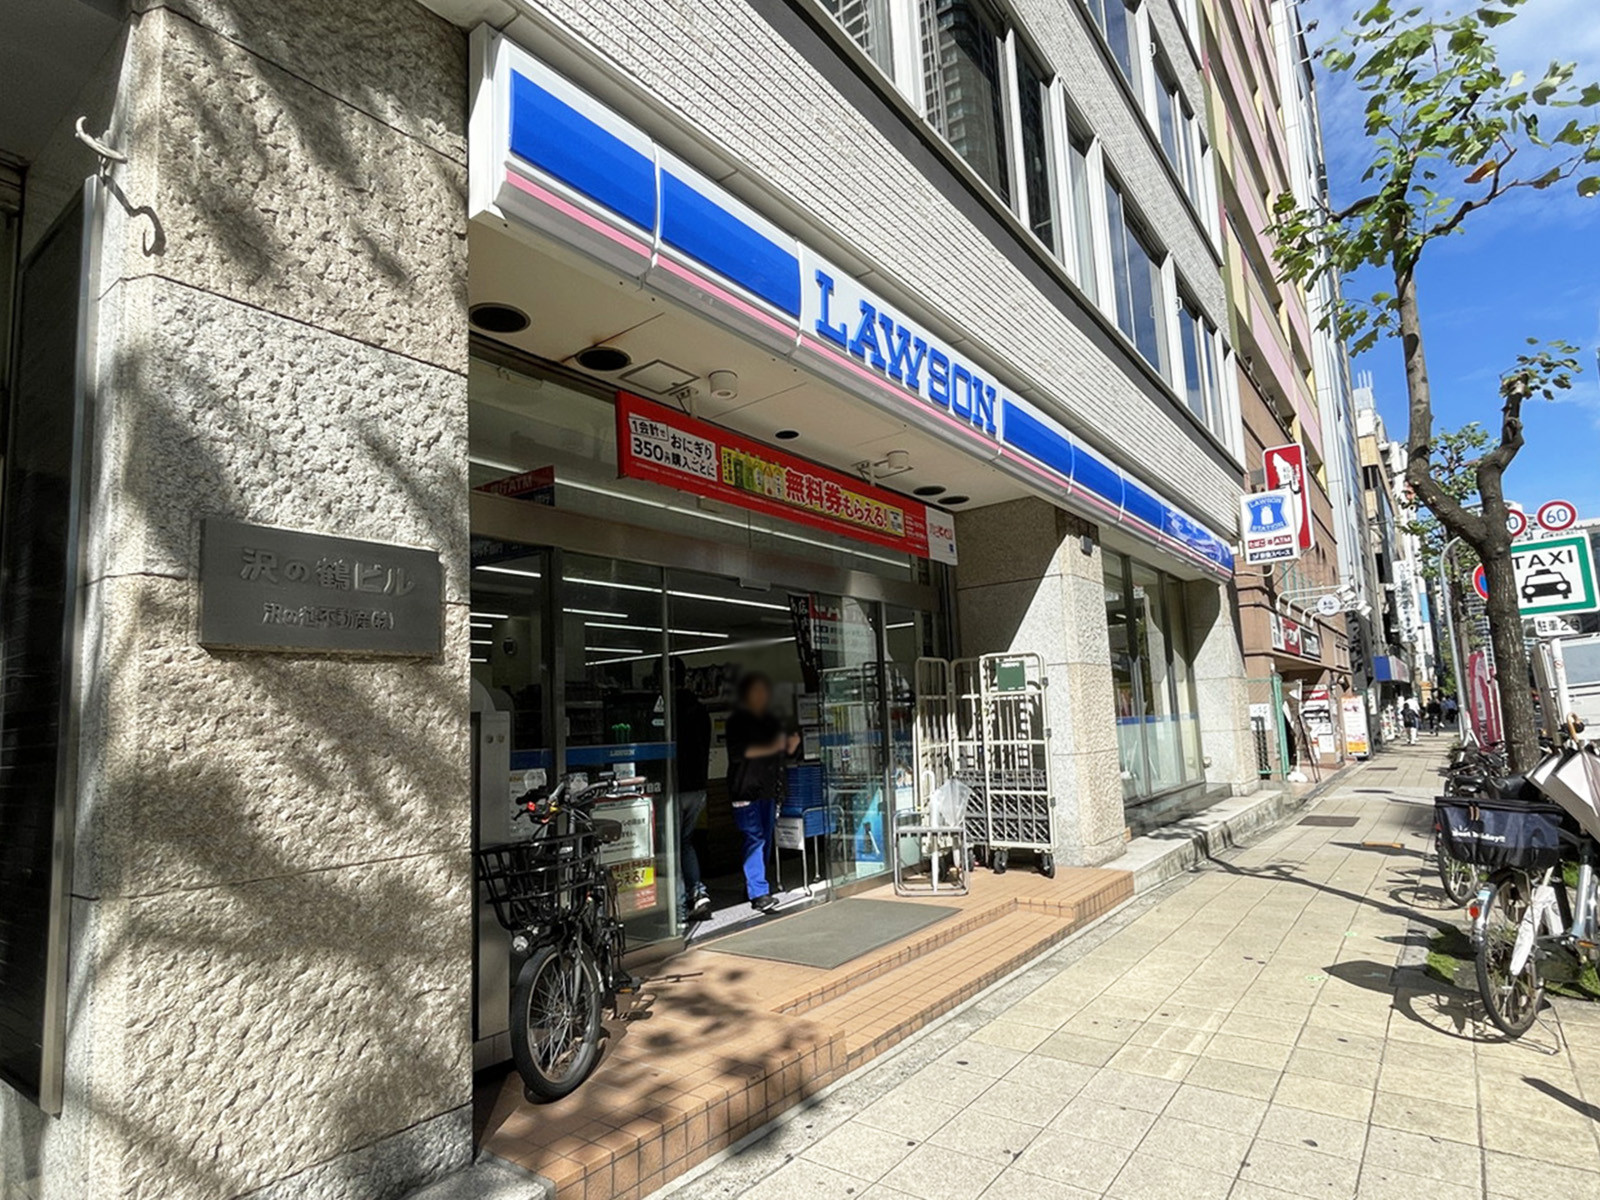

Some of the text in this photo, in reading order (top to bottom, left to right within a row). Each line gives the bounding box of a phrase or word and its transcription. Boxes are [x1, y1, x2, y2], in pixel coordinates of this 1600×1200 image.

[815, 269, 996, 436] LAWSON
[671, 433, 713, 460] おにぎり
[1546, 508, 1568, 524] 60
[240, 548, 415, 596] 沢の鶴ビル
[1511, 549, 1574, 570] TAXI
